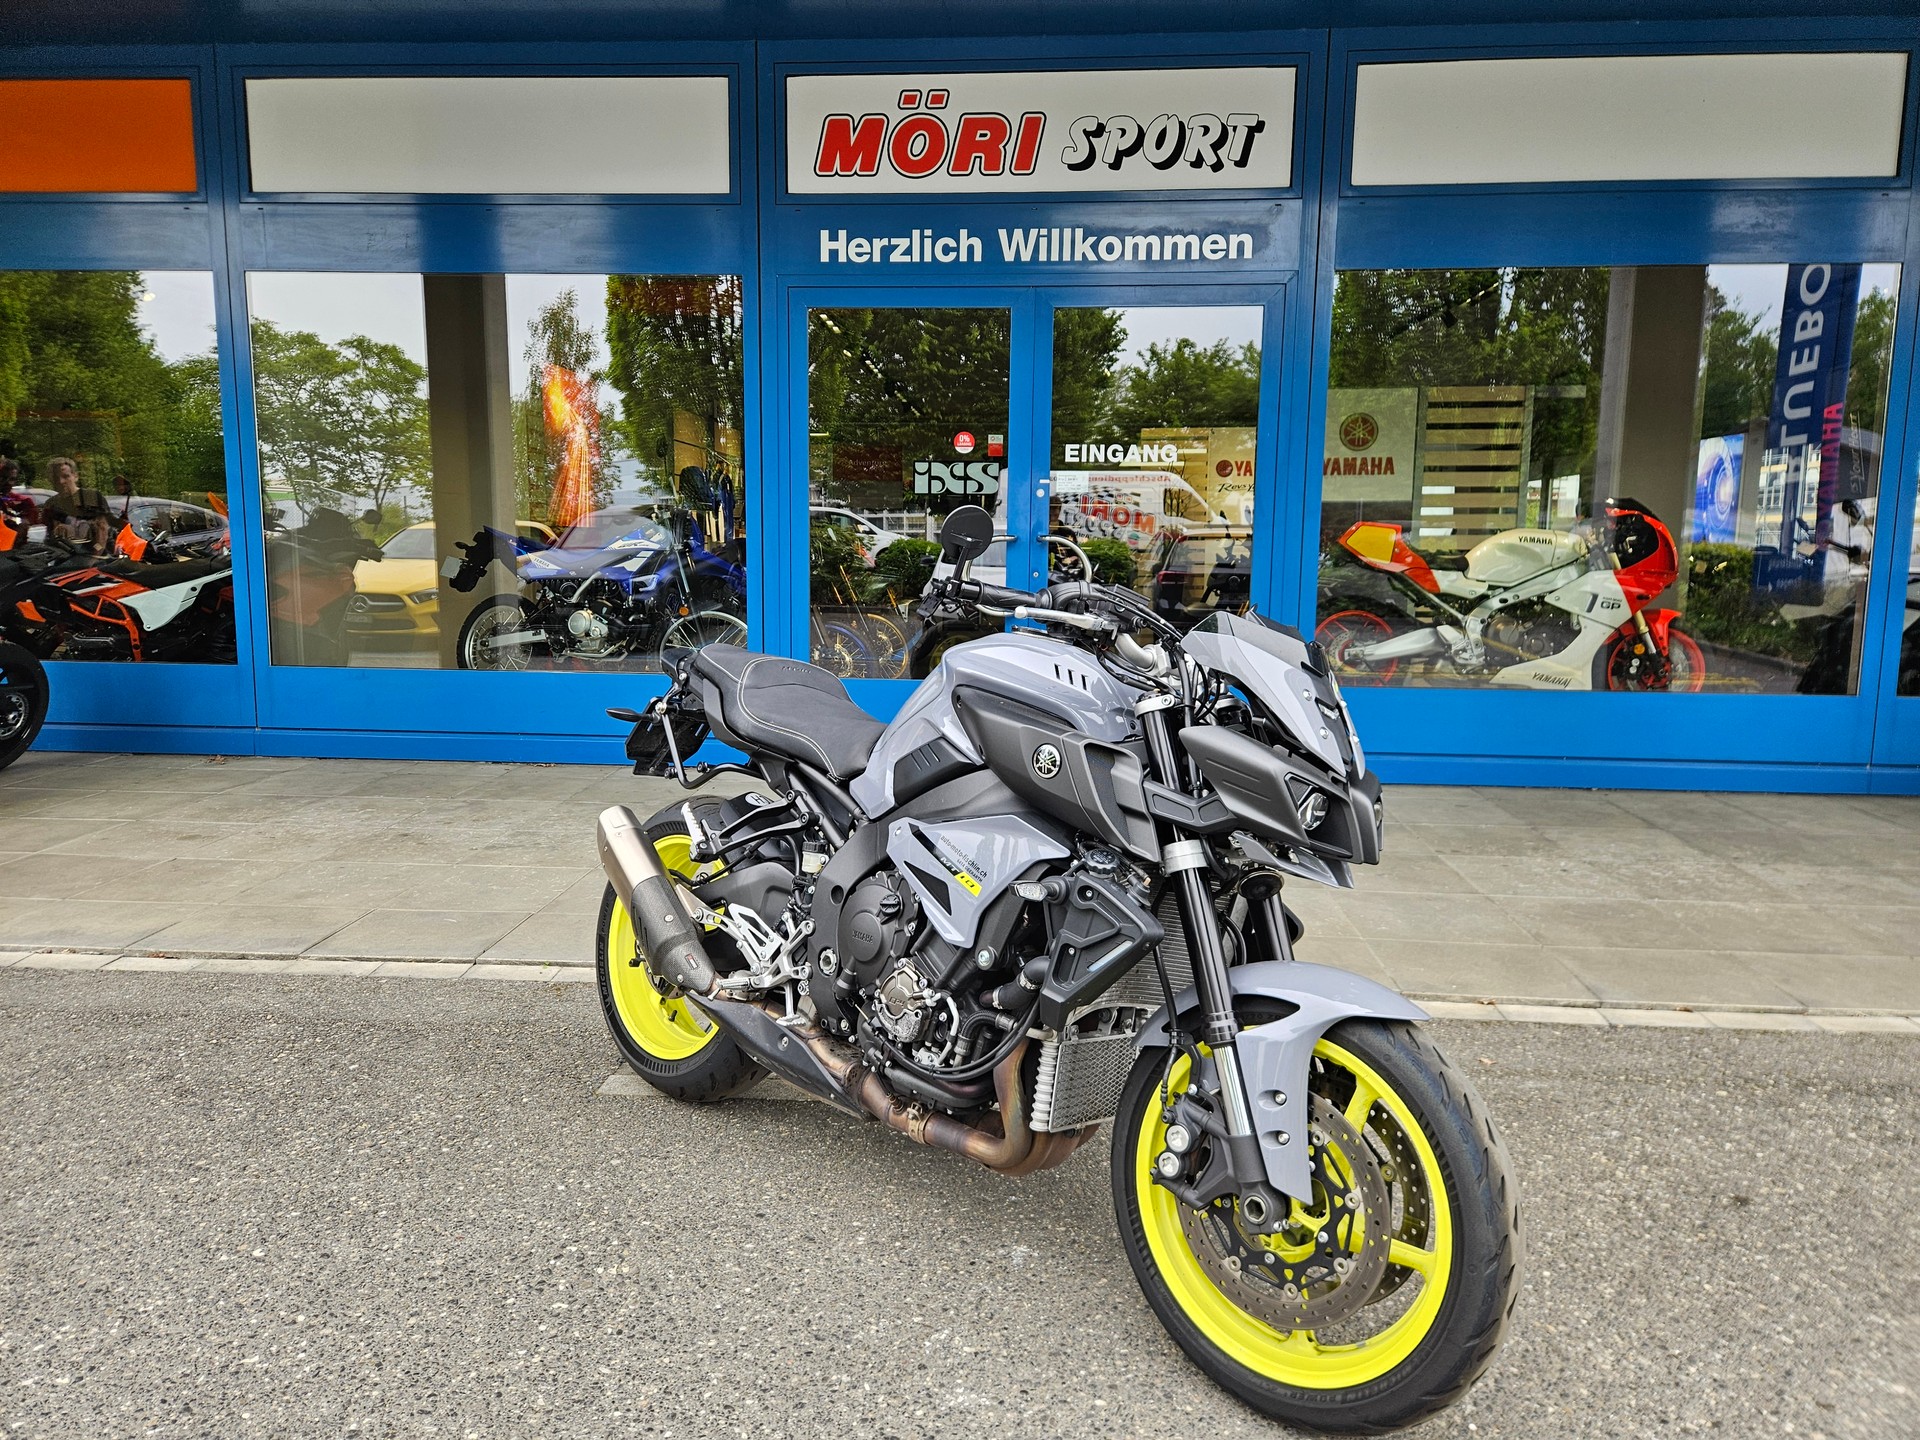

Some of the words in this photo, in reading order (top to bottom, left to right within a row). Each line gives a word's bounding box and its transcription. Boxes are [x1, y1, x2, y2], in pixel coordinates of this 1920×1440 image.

[814, 88, 1047, 178] MÖRI
[1060, 112, 1265, 173] SPORT
[820, 228, 982, 263] Herzlich
[998, 227, 1253, 262] Willkommen
[1065, 443, 1178, 463] EINGANG
[1323, 456, 1395, 476] YAMAHA
[1518, 535, 1553, 545] YAMAHA
[1532, 671, 1569, 687] YAMAHA
[940, 835, 988, 878] auto-moto-fischlin.ch
[940, 856, 960, 875] MT
